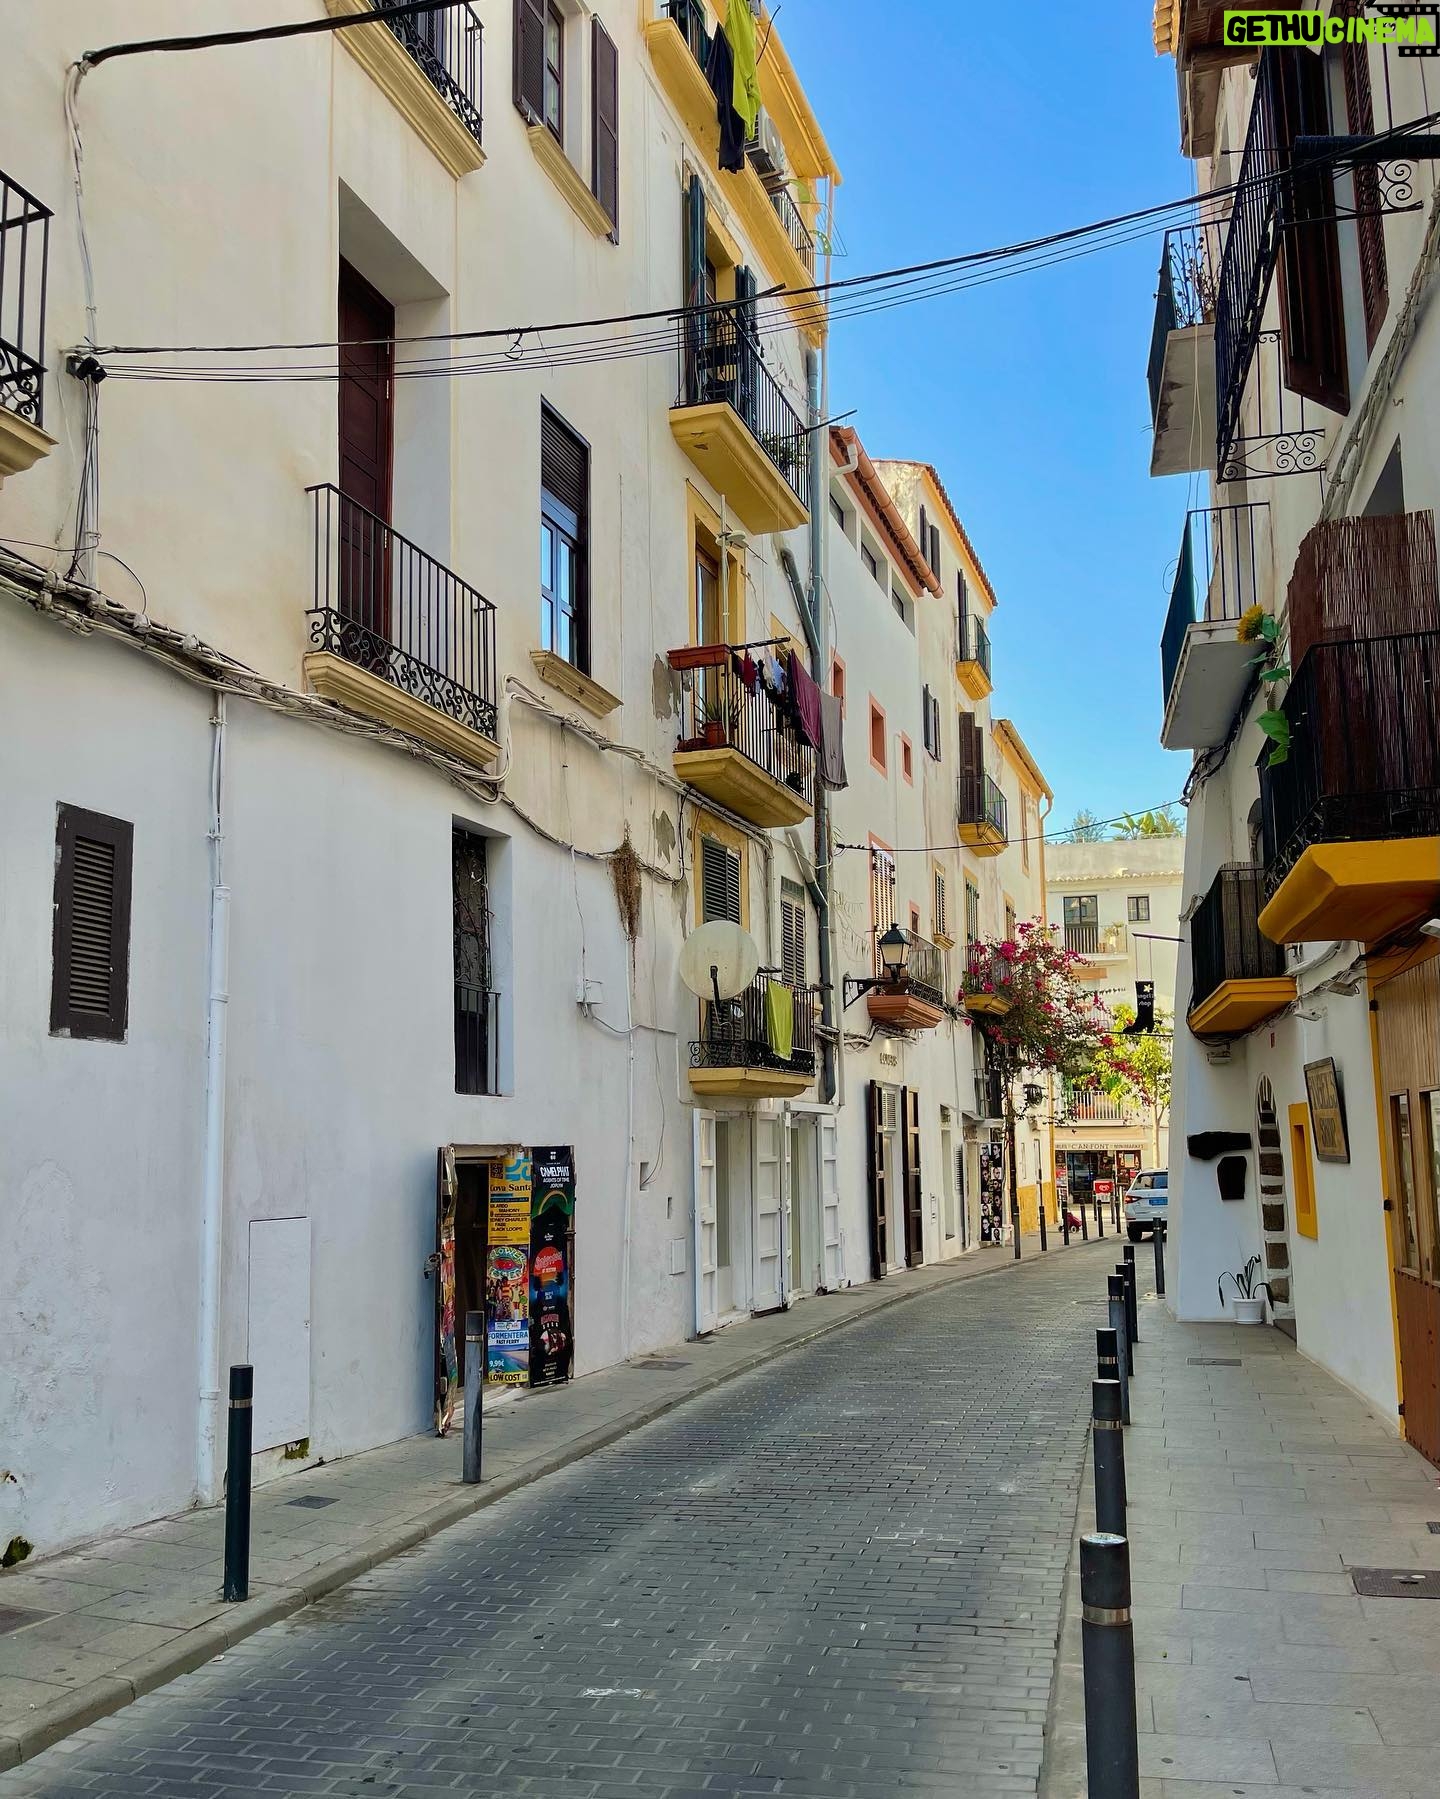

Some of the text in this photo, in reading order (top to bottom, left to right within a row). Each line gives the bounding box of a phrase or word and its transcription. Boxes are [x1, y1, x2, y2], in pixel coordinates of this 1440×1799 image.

[540, 1166, 569, 1177] CAMELPHAT
[488, 1331, 528, 1340] FORMENTERA
[505, 1373, 520, 1381] COST
